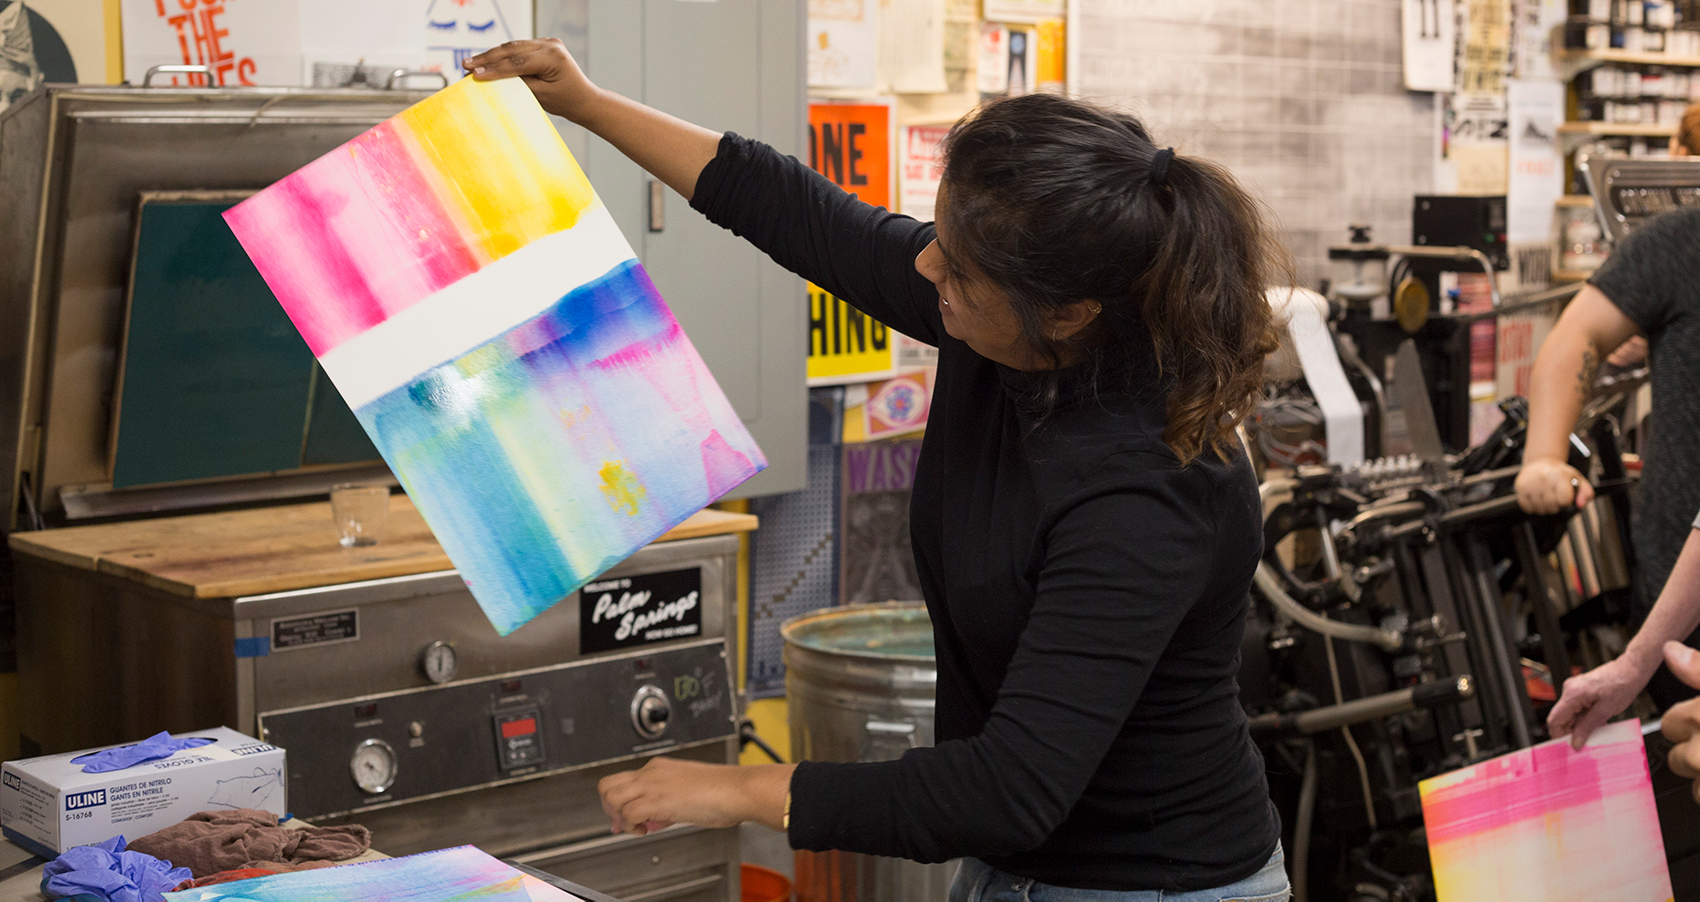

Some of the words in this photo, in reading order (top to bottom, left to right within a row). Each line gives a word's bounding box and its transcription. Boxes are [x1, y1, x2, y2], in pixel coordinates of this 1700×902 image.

[168, 6, 234, 70] THE
[592, 590, 651, 623] Palm
[614, 591, 698, 640] Springs
[232, 744, 274, 756] ULINE
[154, 759, 194, 769] GLOVES
[110, 783, 137, 794] GUANTES
[139, 781, 147, 789] DE
[149, 777, 172, 787] NITRILO
[67, 791, 105, 808] ULINE
[110, 793, 131, 802] GANTS
[142, 787, 163, 796] NITRILE
[65, 811, 93, 821] S-16768
